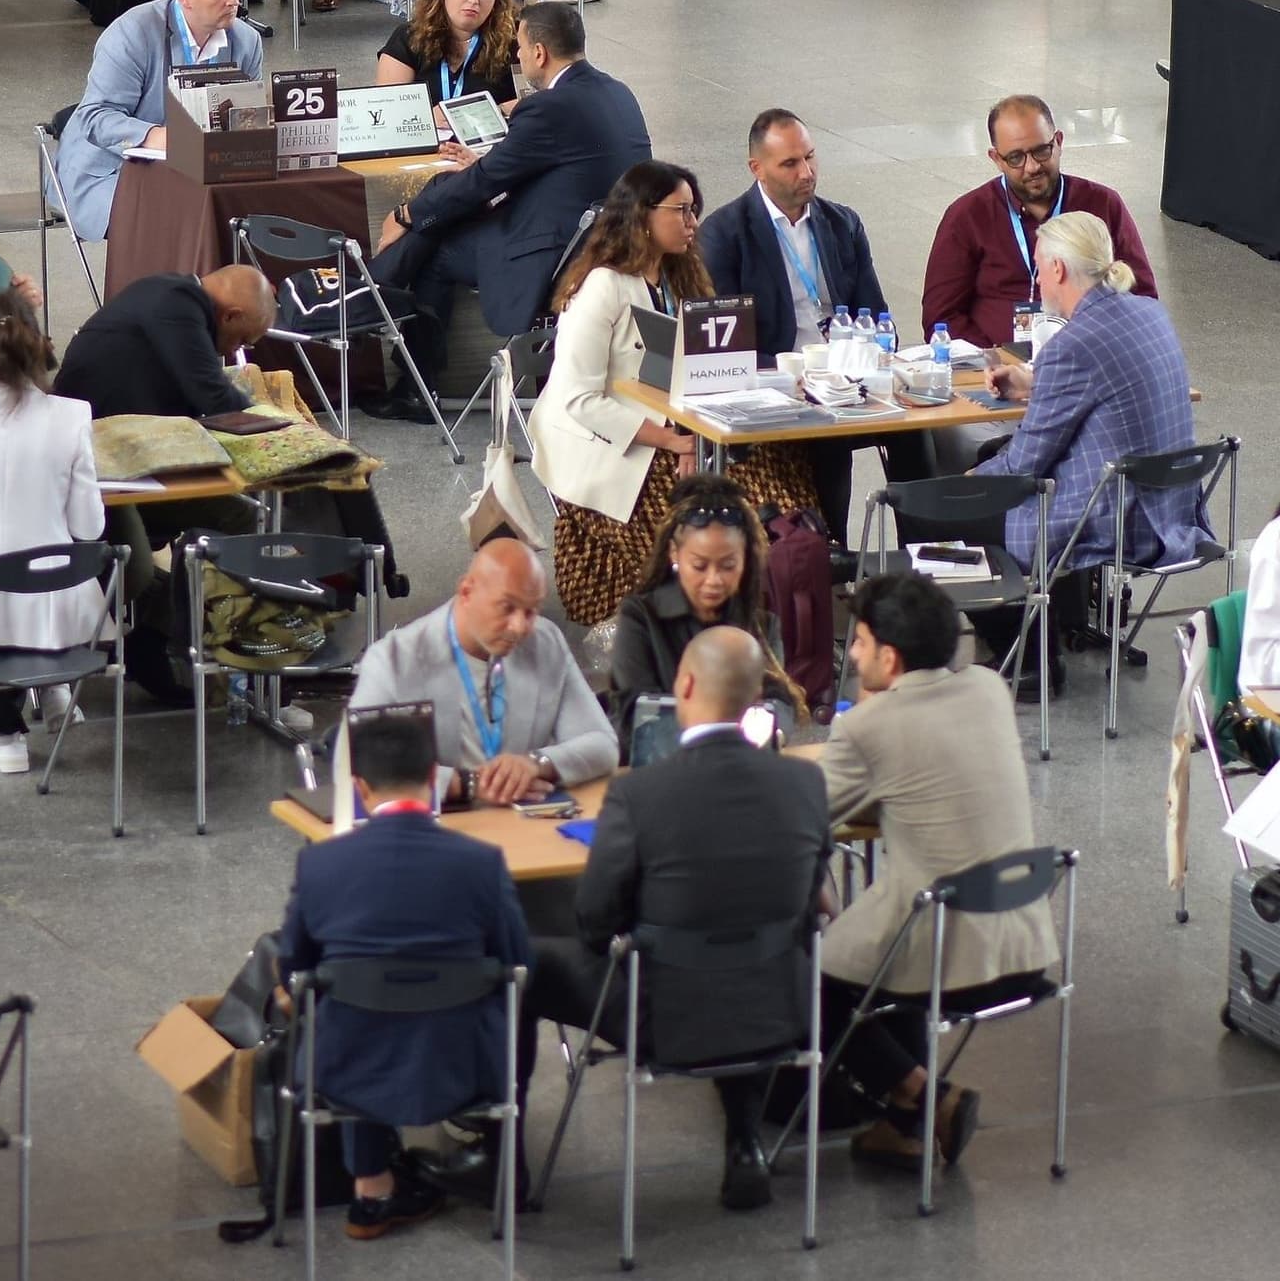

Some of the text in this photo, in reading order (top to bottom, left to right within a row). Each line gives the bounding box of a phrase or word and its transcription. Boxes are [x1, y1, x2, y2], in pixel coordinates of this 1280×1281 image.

[287, 87, 325, 116] 25
[281, 123, 331, 137] PHILLIP
[281, 134, 331, 148] JEFFRIES
[700, 315, 738, 348] 17
[689, 366, 749, 380] HANIMEX
